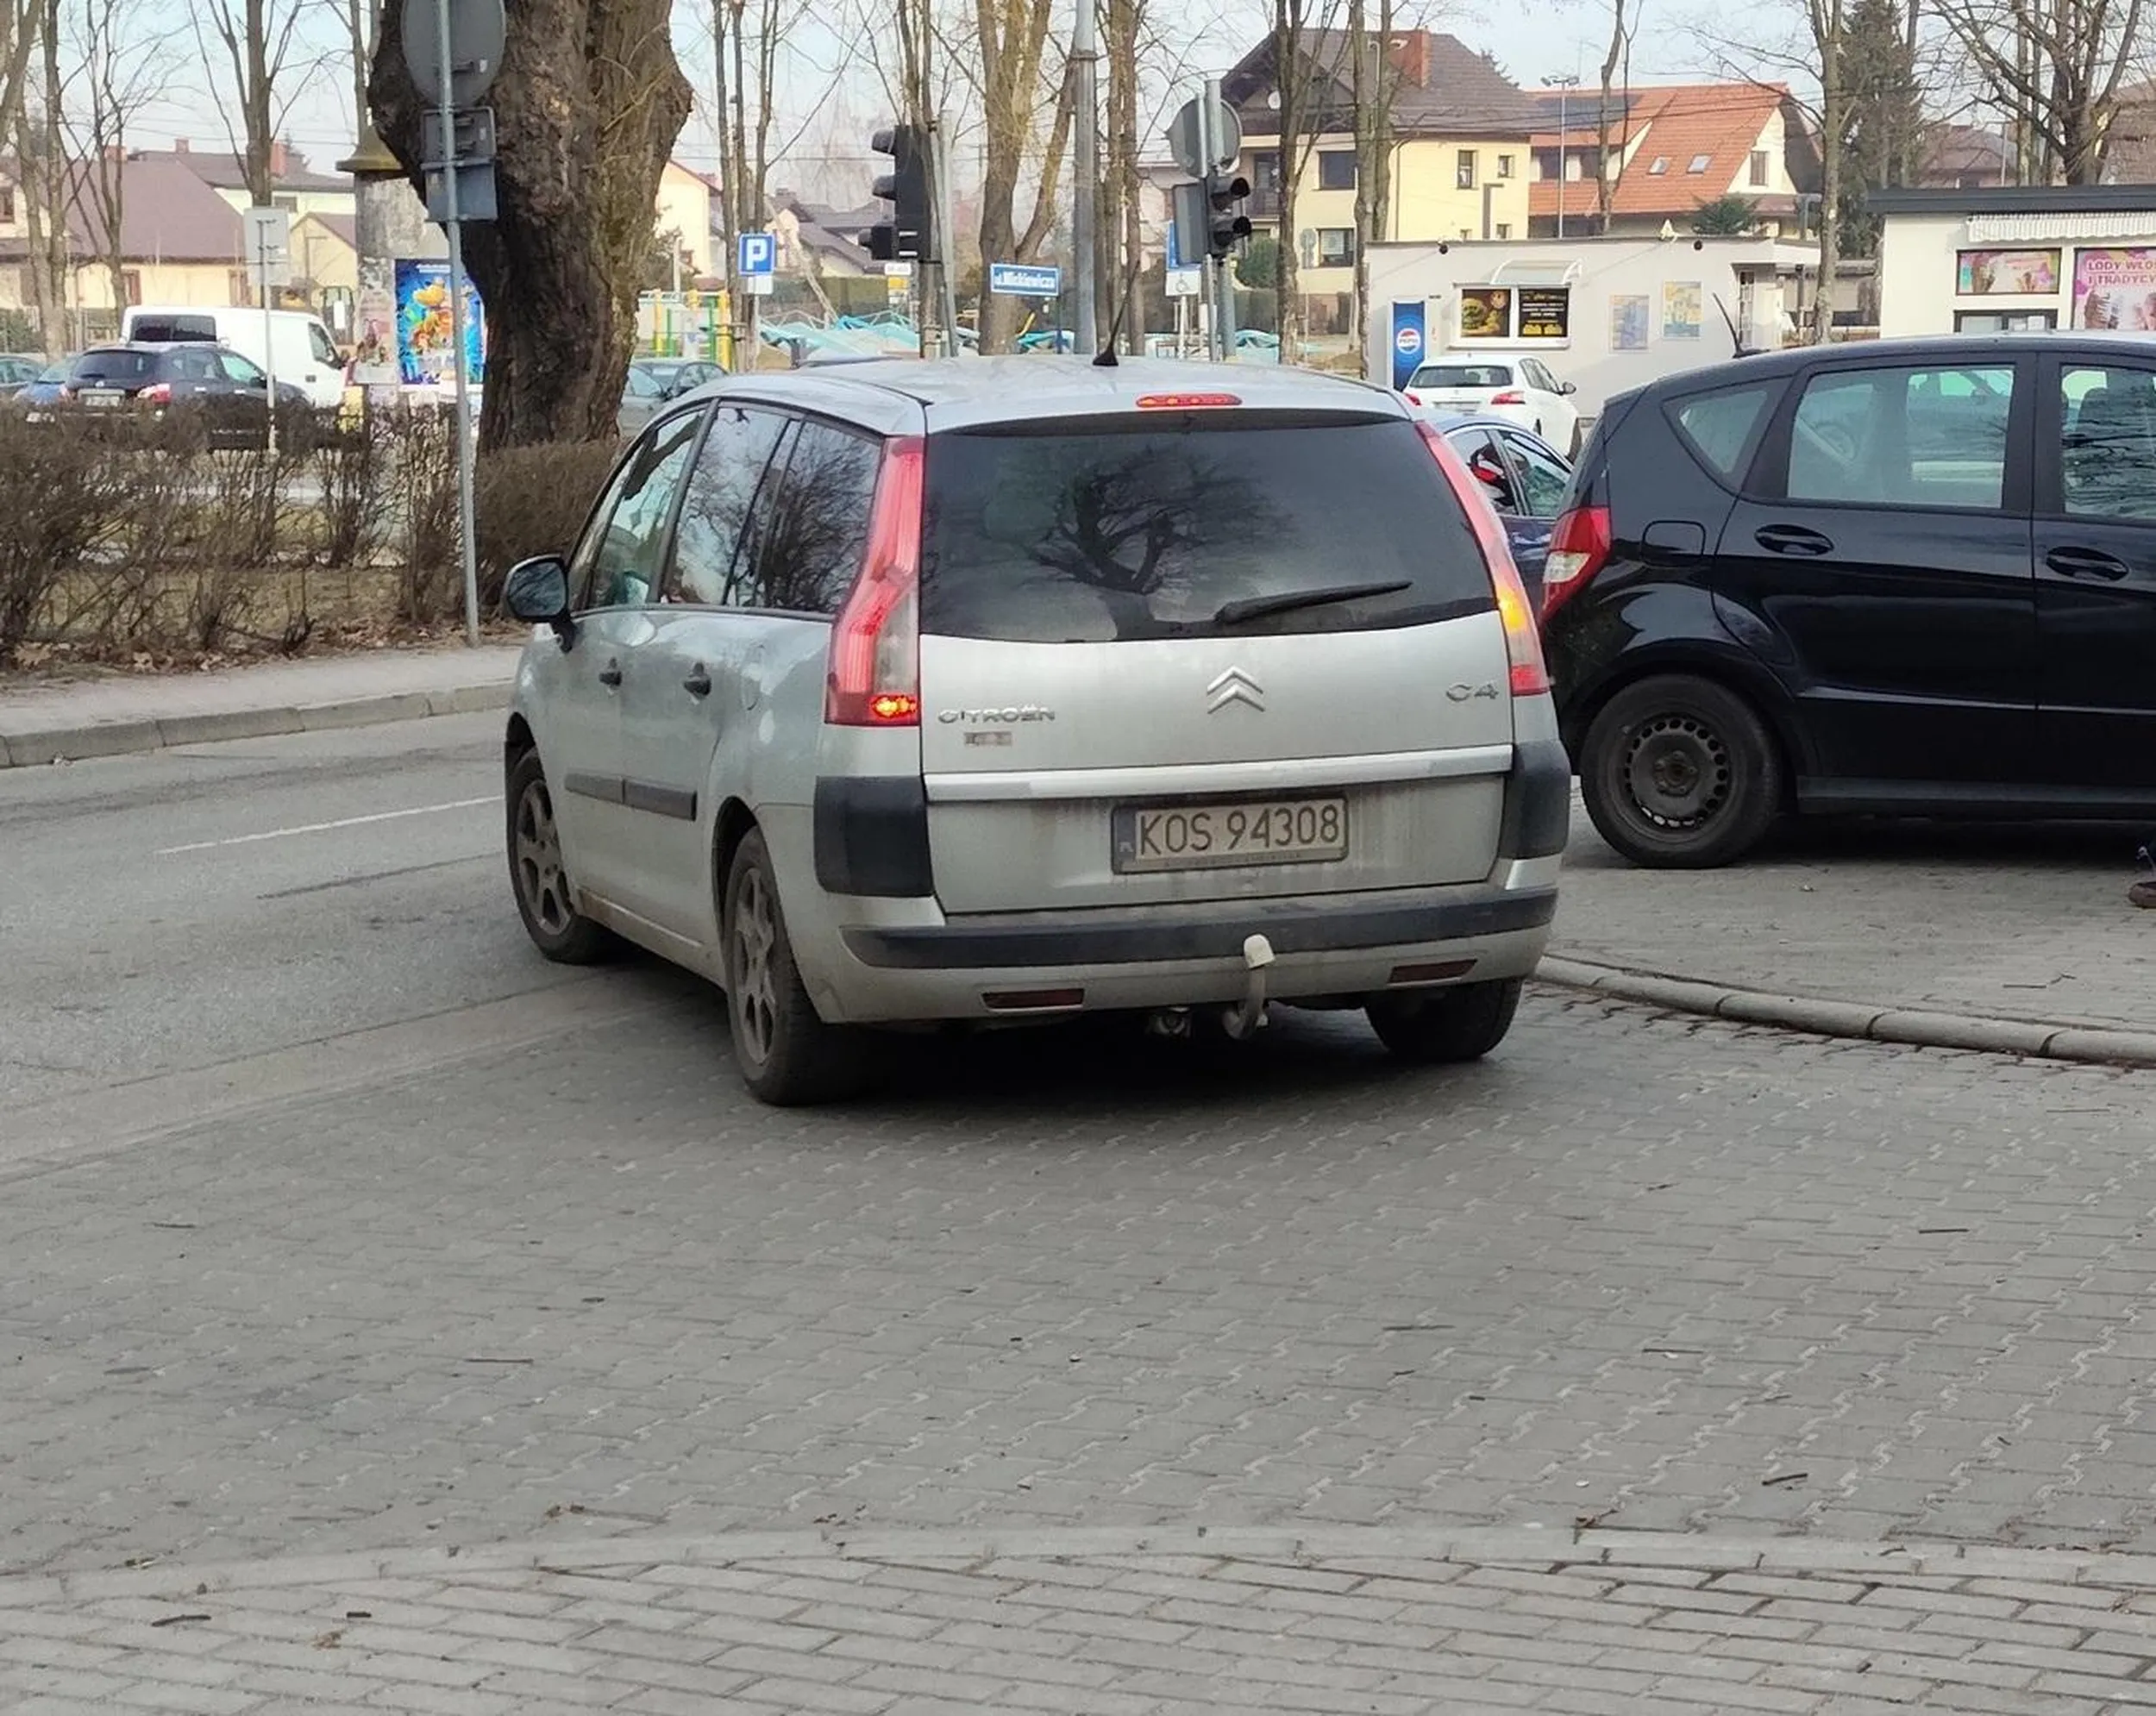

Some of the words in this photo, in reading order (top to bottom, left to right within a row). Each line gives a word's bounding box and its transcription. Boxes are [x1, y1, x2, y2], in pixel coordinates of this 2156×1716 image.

[745, 238, 768, 270] P
[2088, 260, 2122, 271] LODY
[1446, 680, 1499, 702] C4
[1139, 812, 1212, 855] KOS
[1226, 803, 1339, 850] 94308
